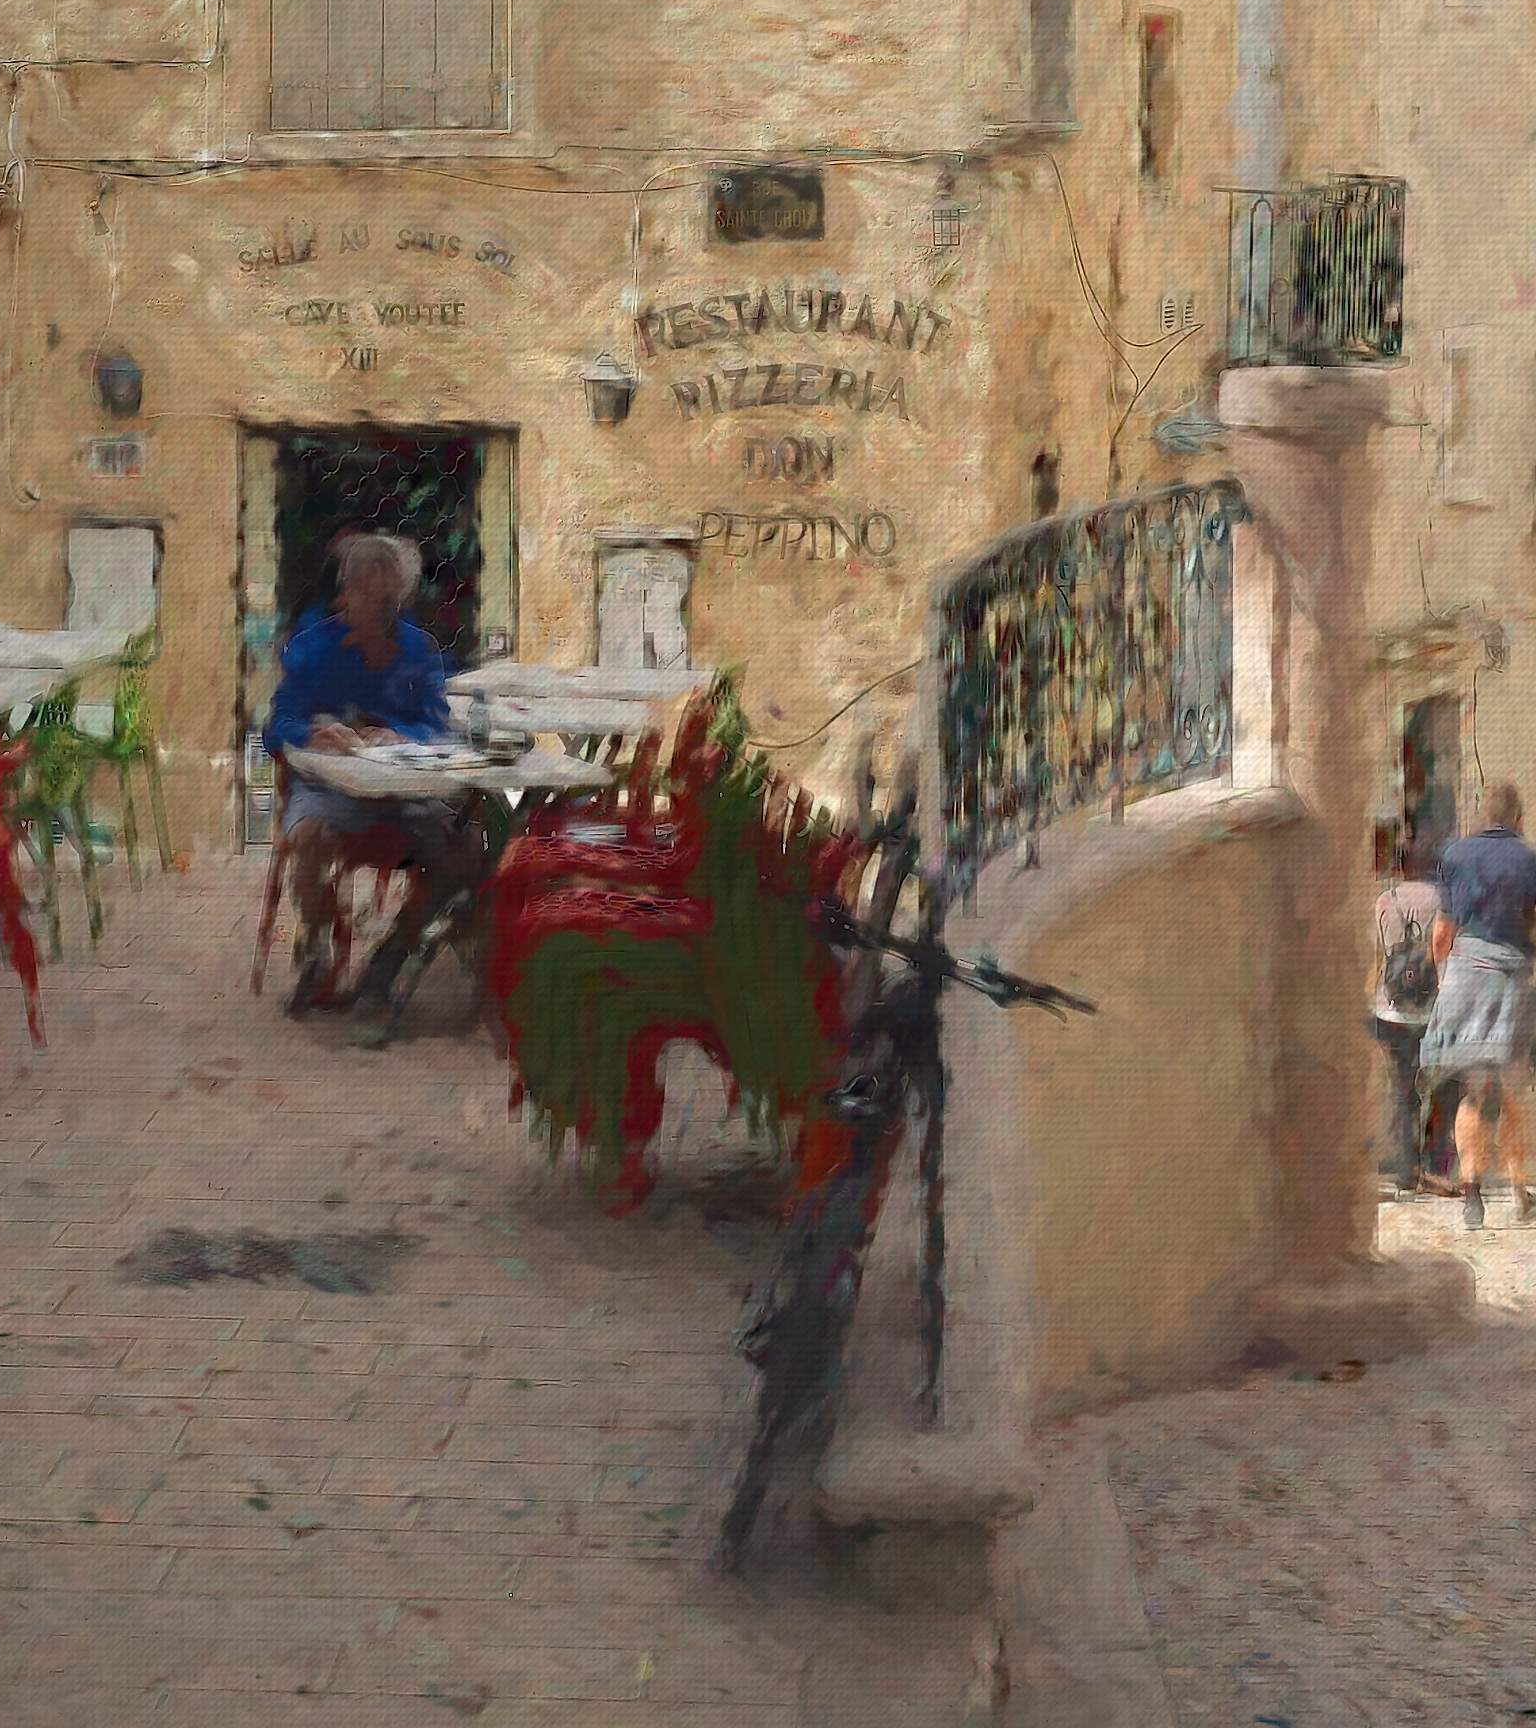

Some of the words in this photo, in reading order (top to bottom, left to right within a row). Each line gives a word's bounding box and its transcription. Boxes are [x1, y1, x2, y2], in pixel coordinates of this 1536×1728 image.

[238, 239, 318, 273] SALLE
[338, 224, 370, 254] AU
[395, 228, 462, 259] SOUS
[284, 301, 349, 326] CAVE
[634, 289, 952, 359] RESTAURANT
[670, 362, 911, 422] PIZZERIA
[744, 435, 835, 482] DON
[697, 511, 897, 562] PEPPINO
